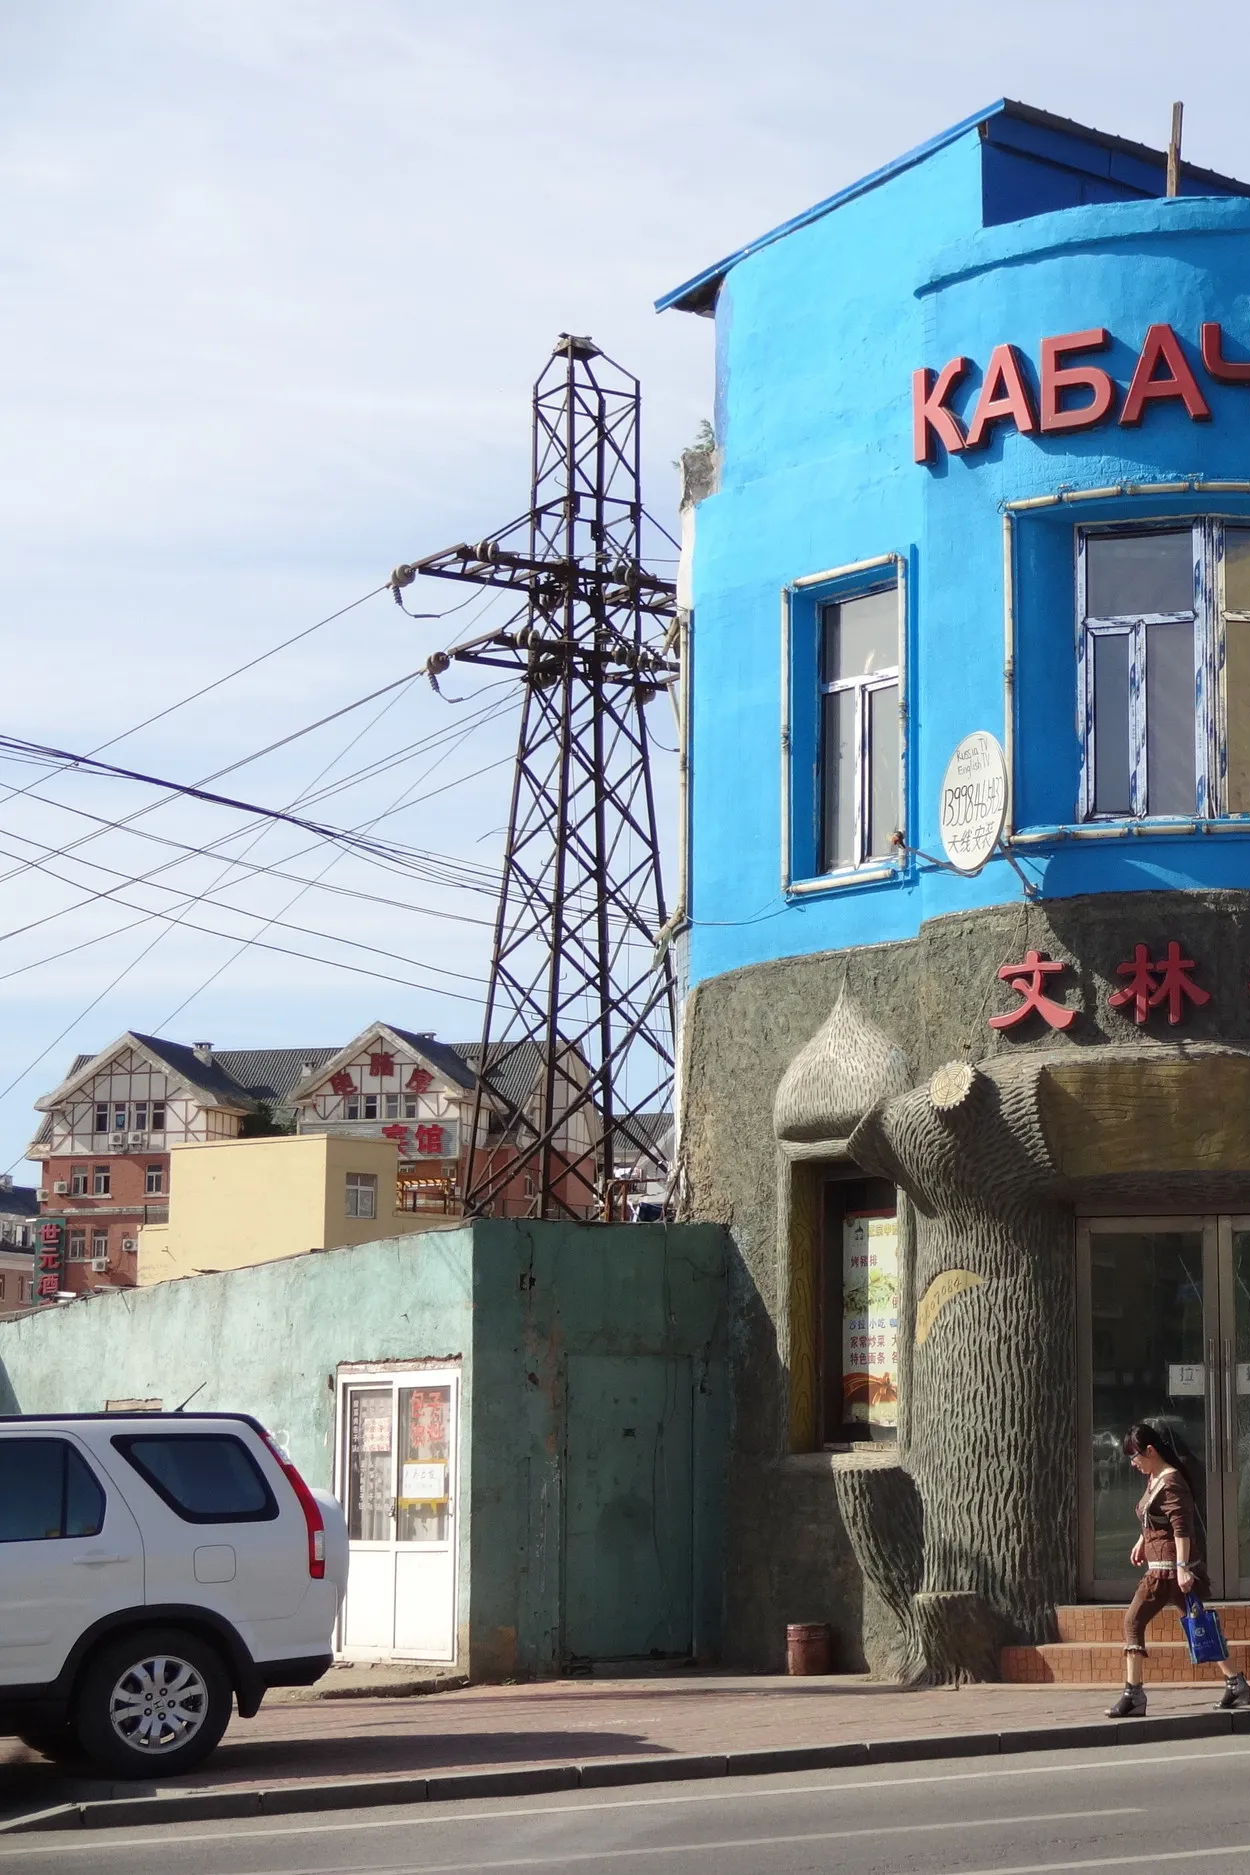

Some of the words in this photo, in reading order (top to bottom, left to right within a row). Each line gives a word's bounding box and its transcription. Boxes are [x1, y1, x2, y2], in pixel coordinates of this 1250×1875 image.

[978, 737, 989, 753] TV
[957, 758, 981, 778] English
[981, 752, 990, 768] TV
[37, 1223, 61, 1304] 世元酒
